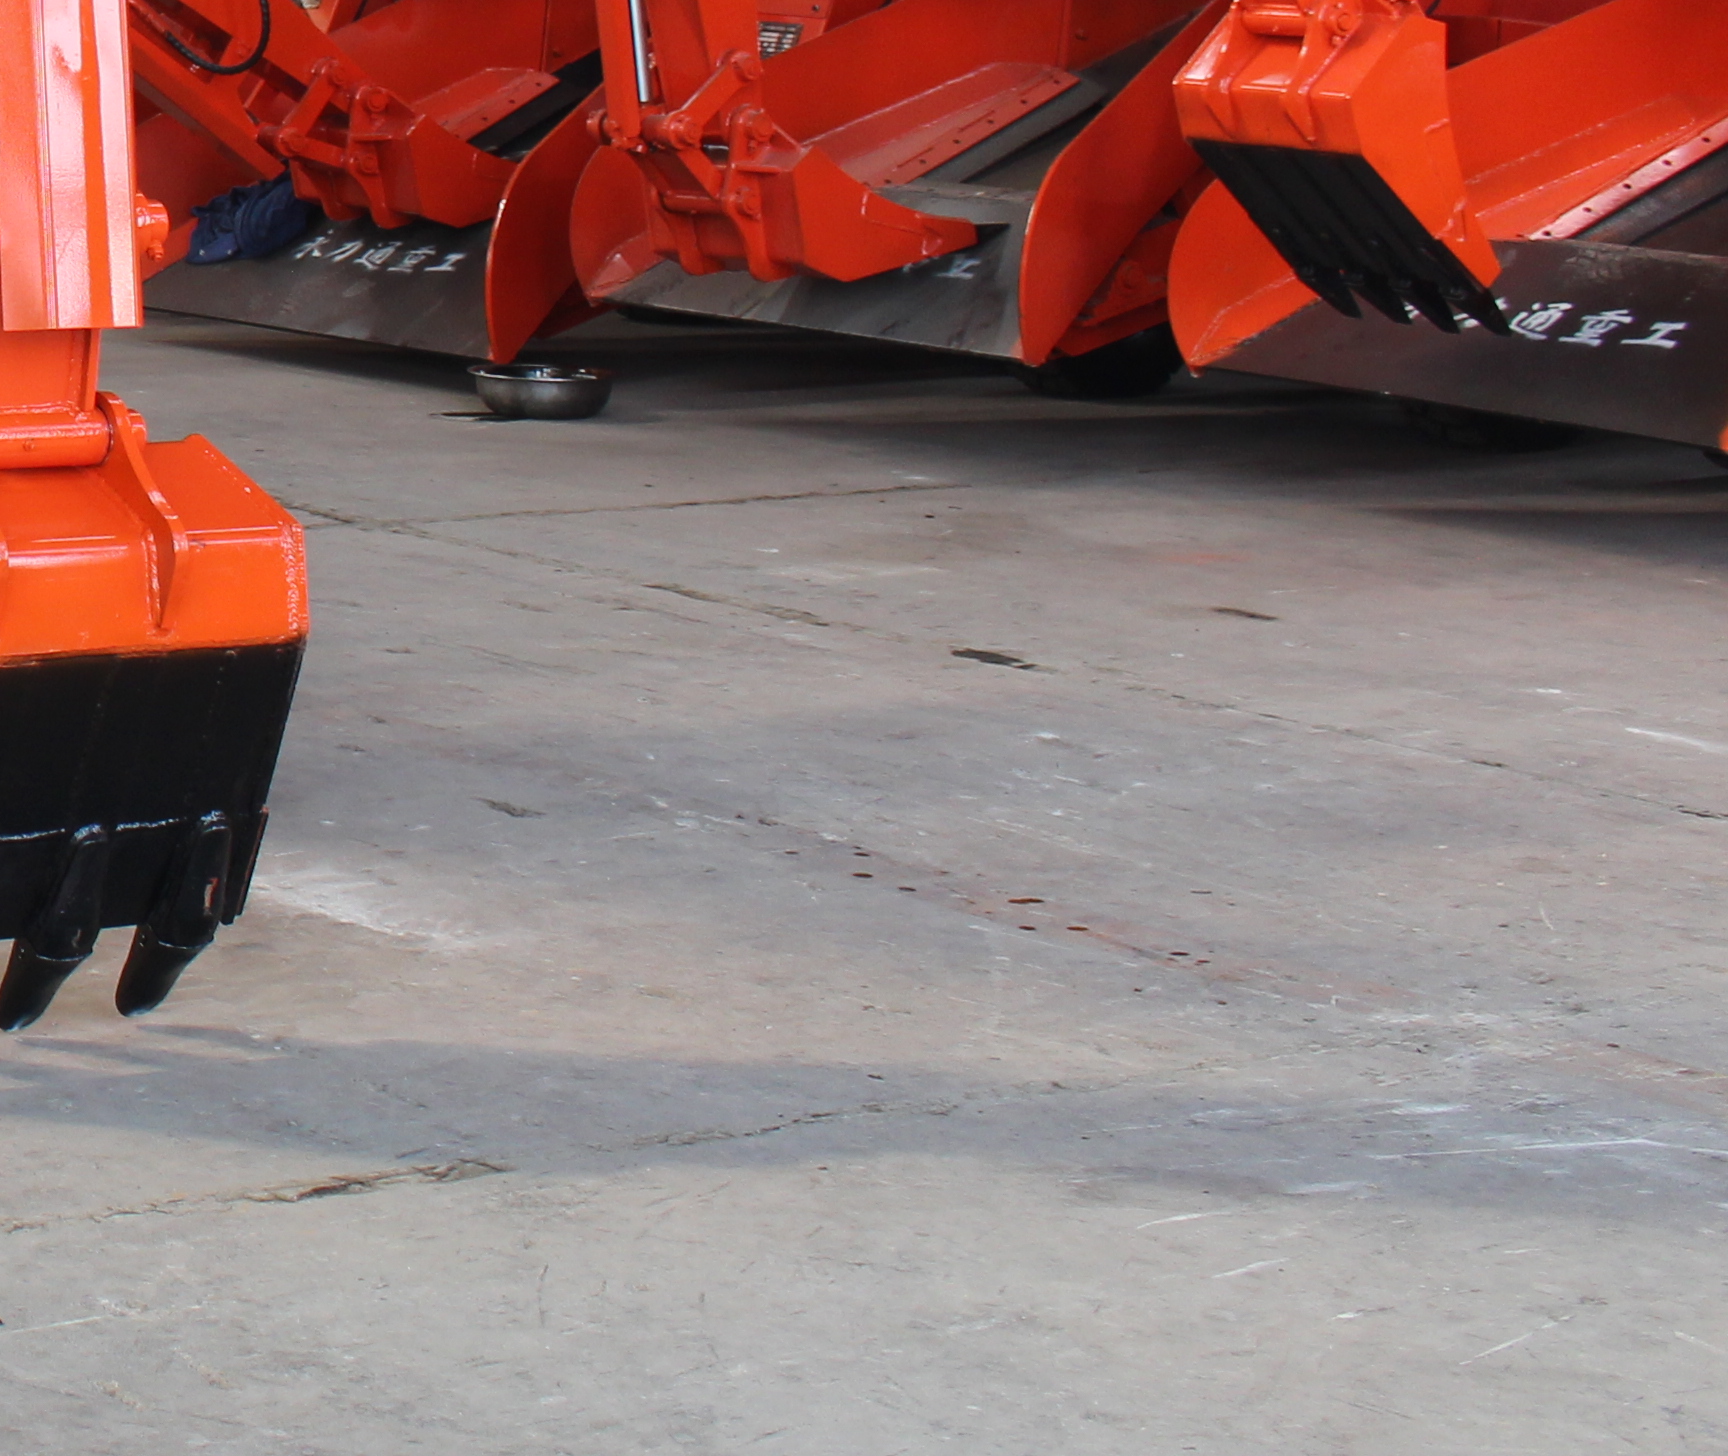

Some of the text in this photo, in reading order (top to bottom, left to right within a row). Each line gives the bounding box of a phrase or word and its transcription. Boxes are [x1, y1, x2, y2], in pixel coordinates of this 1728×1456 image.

[293, 228, 467, 274] 永力通重工
